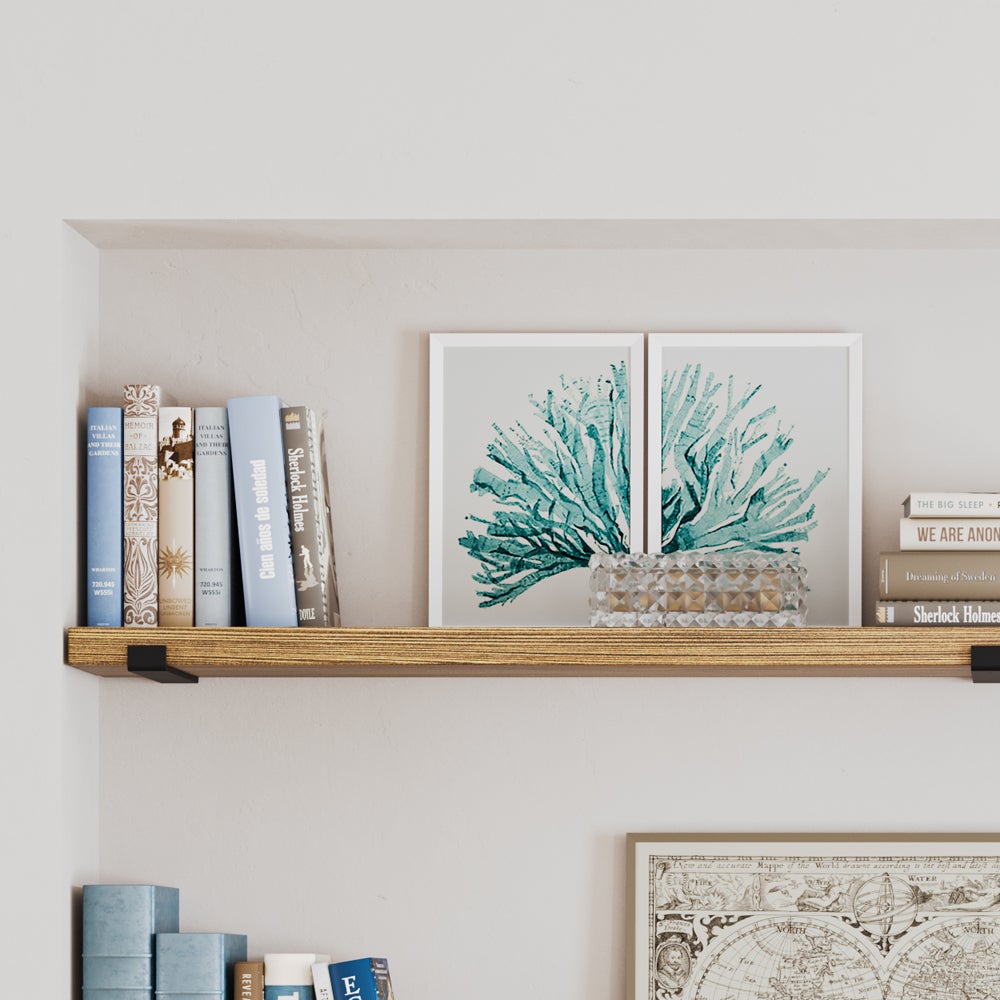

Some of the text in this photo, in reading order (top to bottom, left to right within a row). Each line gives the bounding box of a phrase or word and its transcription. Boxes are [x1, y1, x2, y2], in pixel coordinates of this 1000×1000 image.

[287, 447, 309, 533] Sherlock Holmes
[917, 500, 935, 509] THE
[937, 500, 954, 509] BIG
[958, 501, 984, 509] SLEEP
[250, 459, 276, 580] Cien años de soledad
[917, 527, 936, 542] WE
[939, 527, 964, 542] ARE
[905, 569, 997, 584] Dreaming of Sweden
[299, 607, 316, 621] DOYLE
[913, 605, 960, 624] Sherlock
[757, 862, 784, 872] Mappe
[908, 874, 937, 882] WATER
[775, 925, 807, 935] NORTH
[963, 927, 994, 935] NORTH
